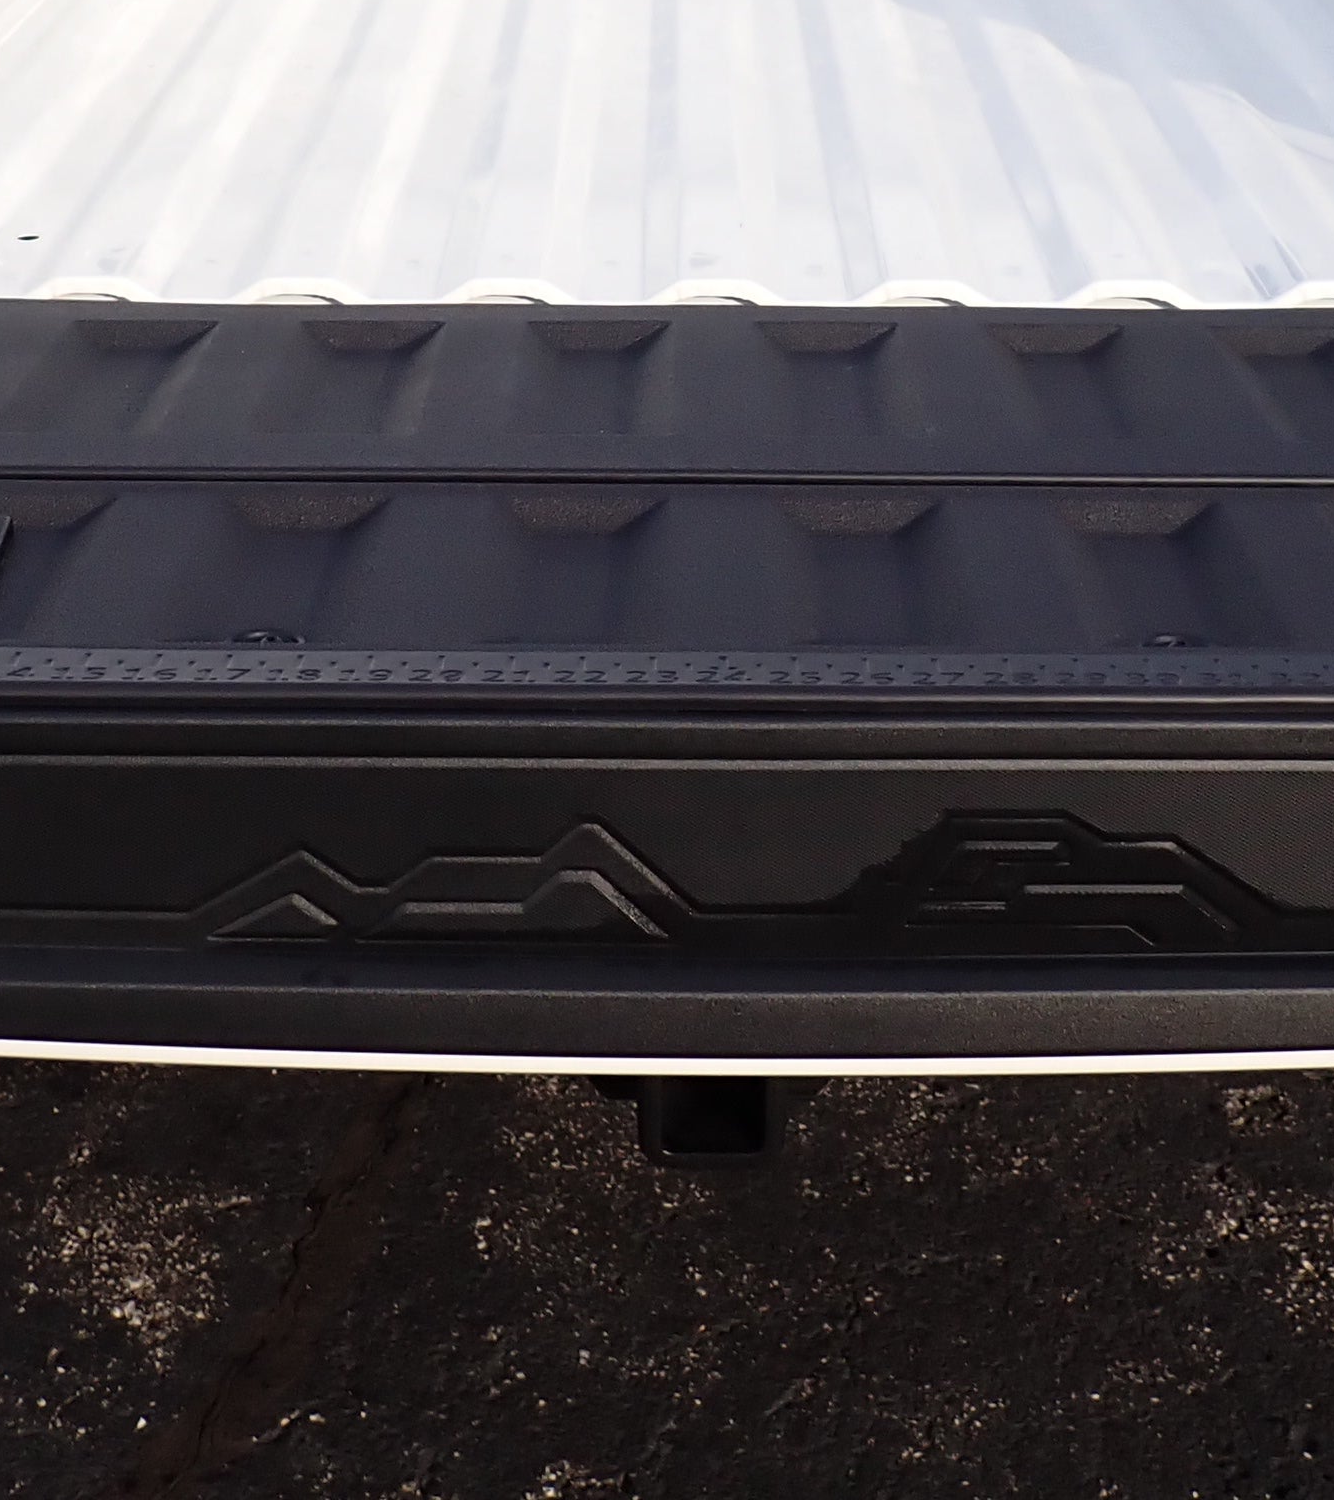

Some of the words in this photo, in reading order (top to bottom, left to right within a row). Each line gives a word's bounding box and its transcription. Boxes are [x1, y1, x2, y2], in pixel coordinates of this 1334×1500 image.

[51, 667, 107, 680] 15
[121, 667, 177, 681] 16
[193, 668, 252, 681] 17
[266, 668, 322, 682] 18
[338, 669, 393, 682] 19
[552, 670, 607, 683] 22
[625, 670, 680, 684] 23
[769, 671, 822, 685] 25
[840, 672, 895, 685] 26
[912, 672, 965, 685] 27
